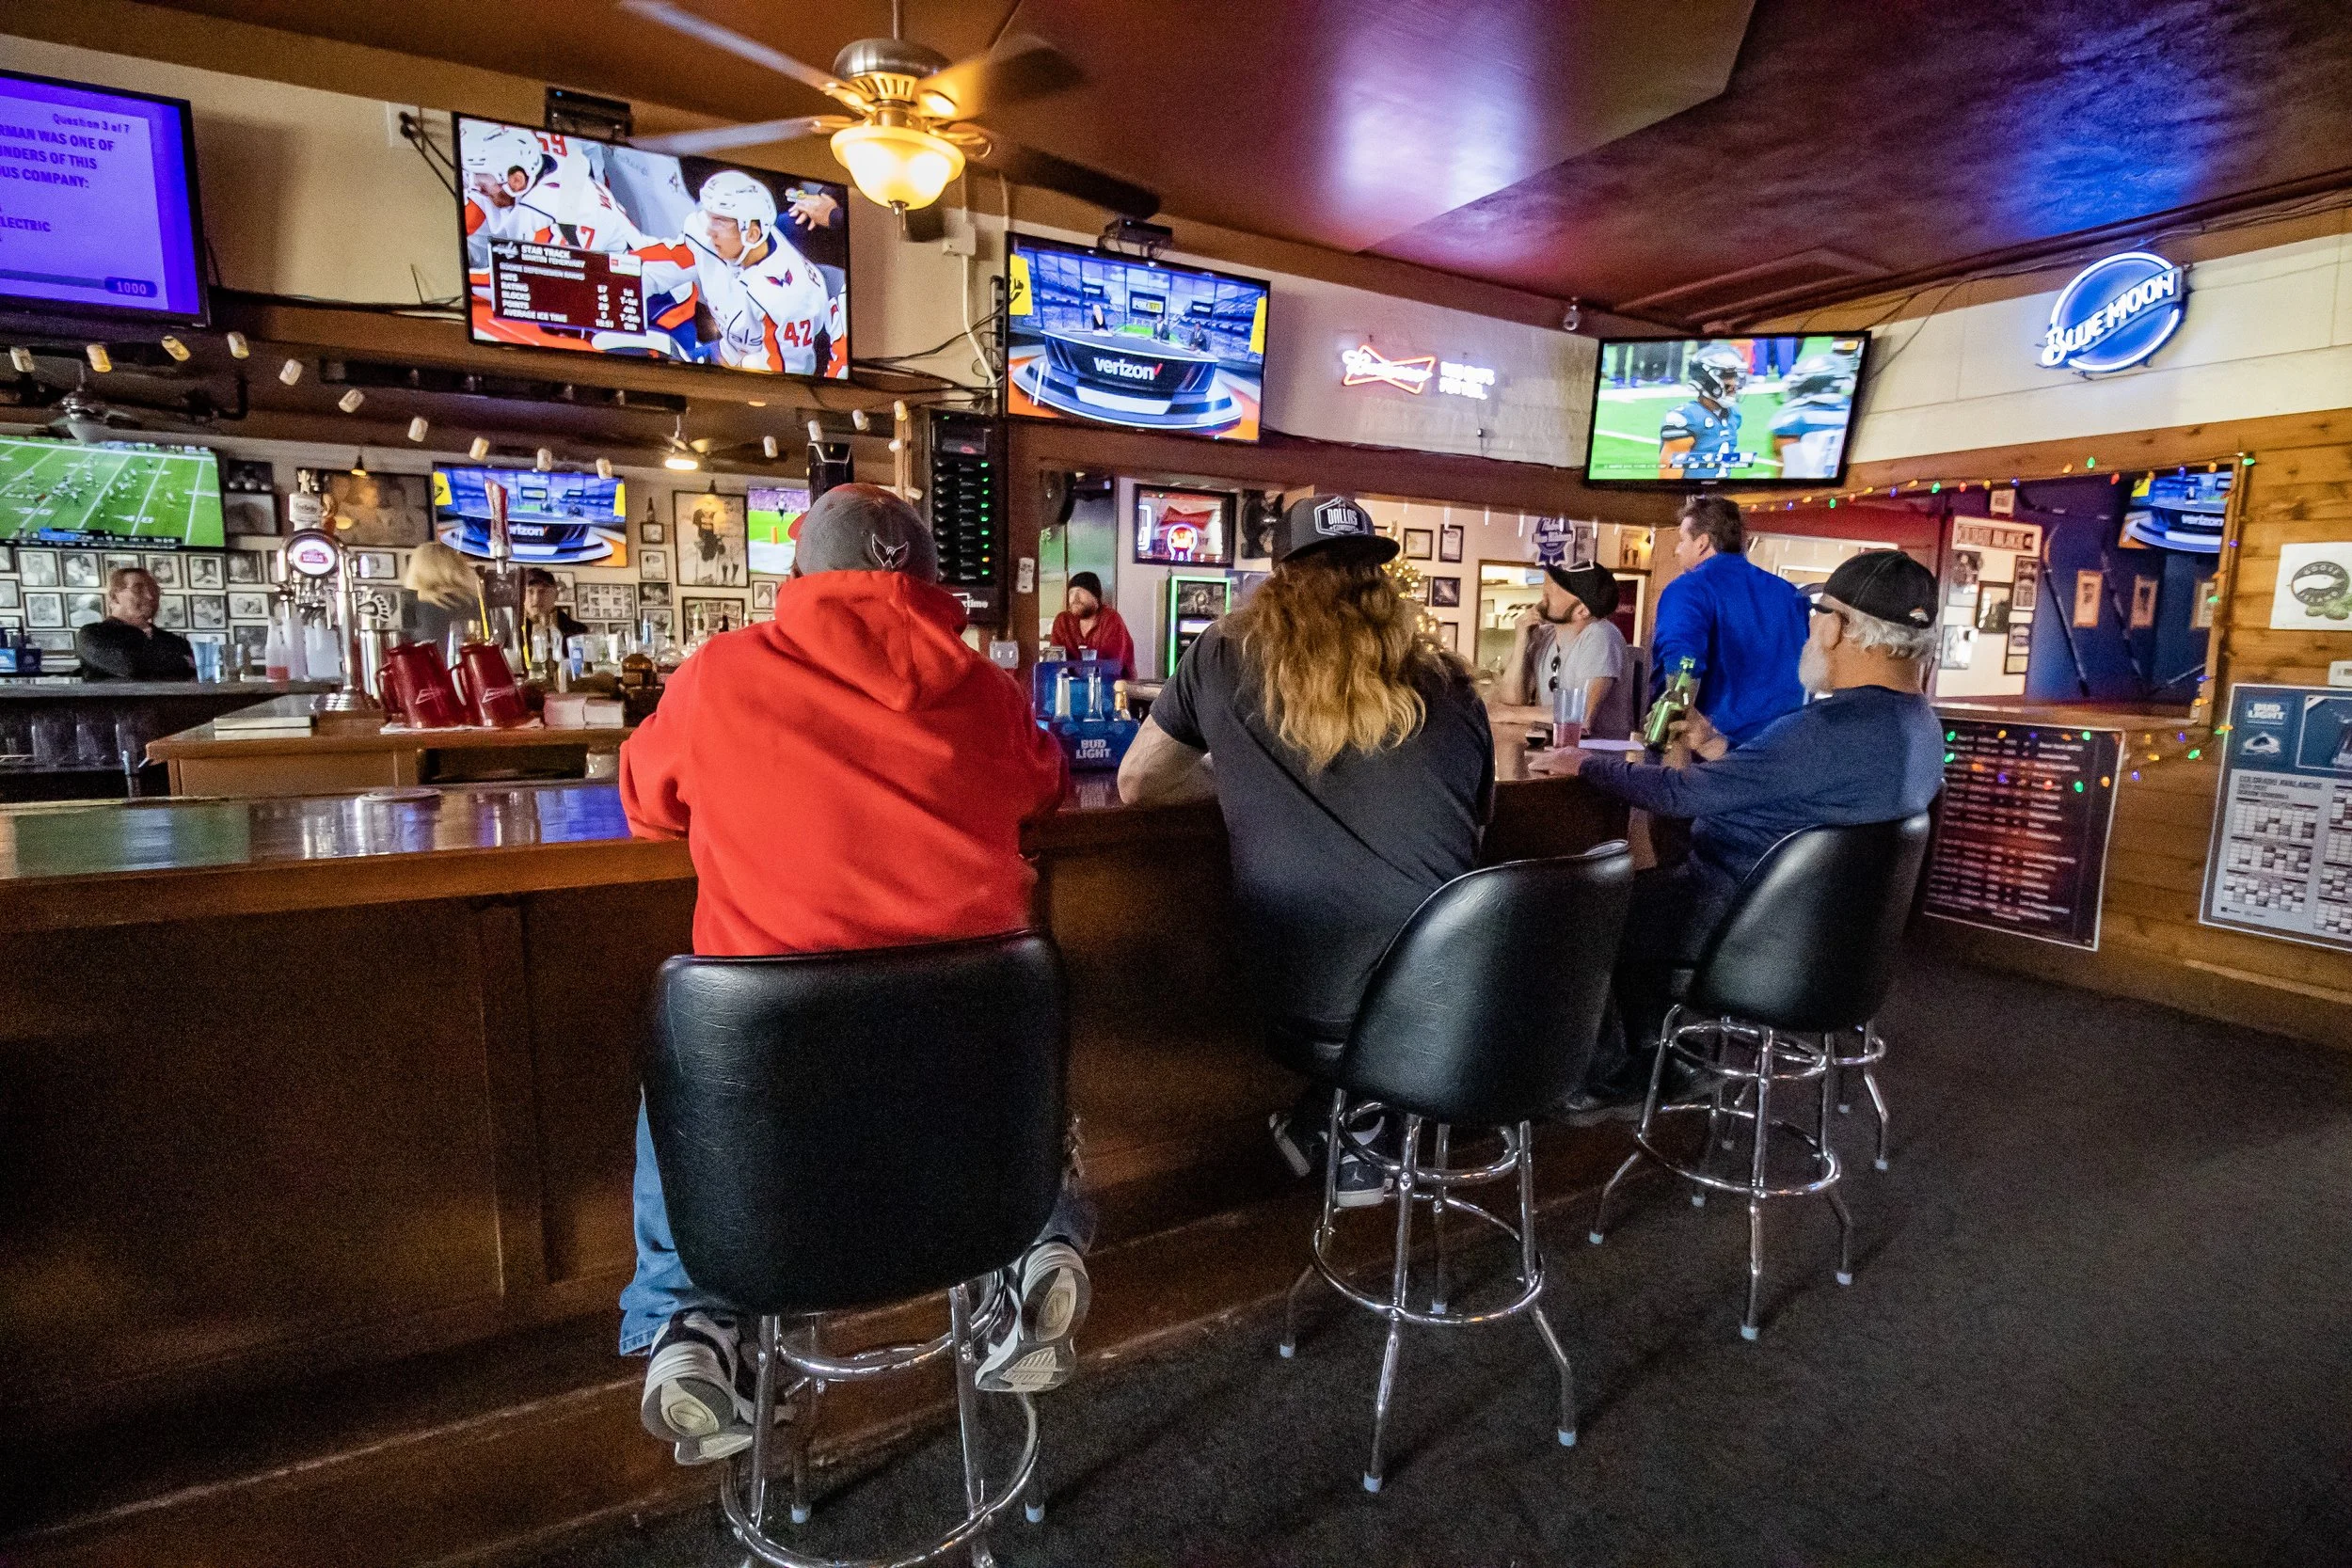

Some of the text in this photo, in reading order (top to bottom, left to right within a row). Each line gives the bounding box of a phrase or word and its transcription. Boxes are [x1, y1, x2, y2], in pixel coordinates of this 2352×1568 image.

[53, 113, 130, 134] Question 3 of 7
[37, 130, 67, 145] WAS
[70, 135, 96, 150] ONE
[98, 139, 115, 151] OF
[50, 151, 66, 165] OF
[68, 153, 98, 169] THIS
[22, 167, 89, 188] COMPANY:
[520, 245, 544, 256] STAR
[543, 246, 571, 260] TRACK
[117, 280, 147, 294] 1000
[2042, 271, 2174, 367] BLUE MOON
[783, 319, 813, 347] 42
[1093, 356, 1155, 381] verizon
[1327, 508, 1359, 526] DALLAS
[1075, 748, 1112, 759] LIGHT
[1081, 738, 1107, 750] BUD
